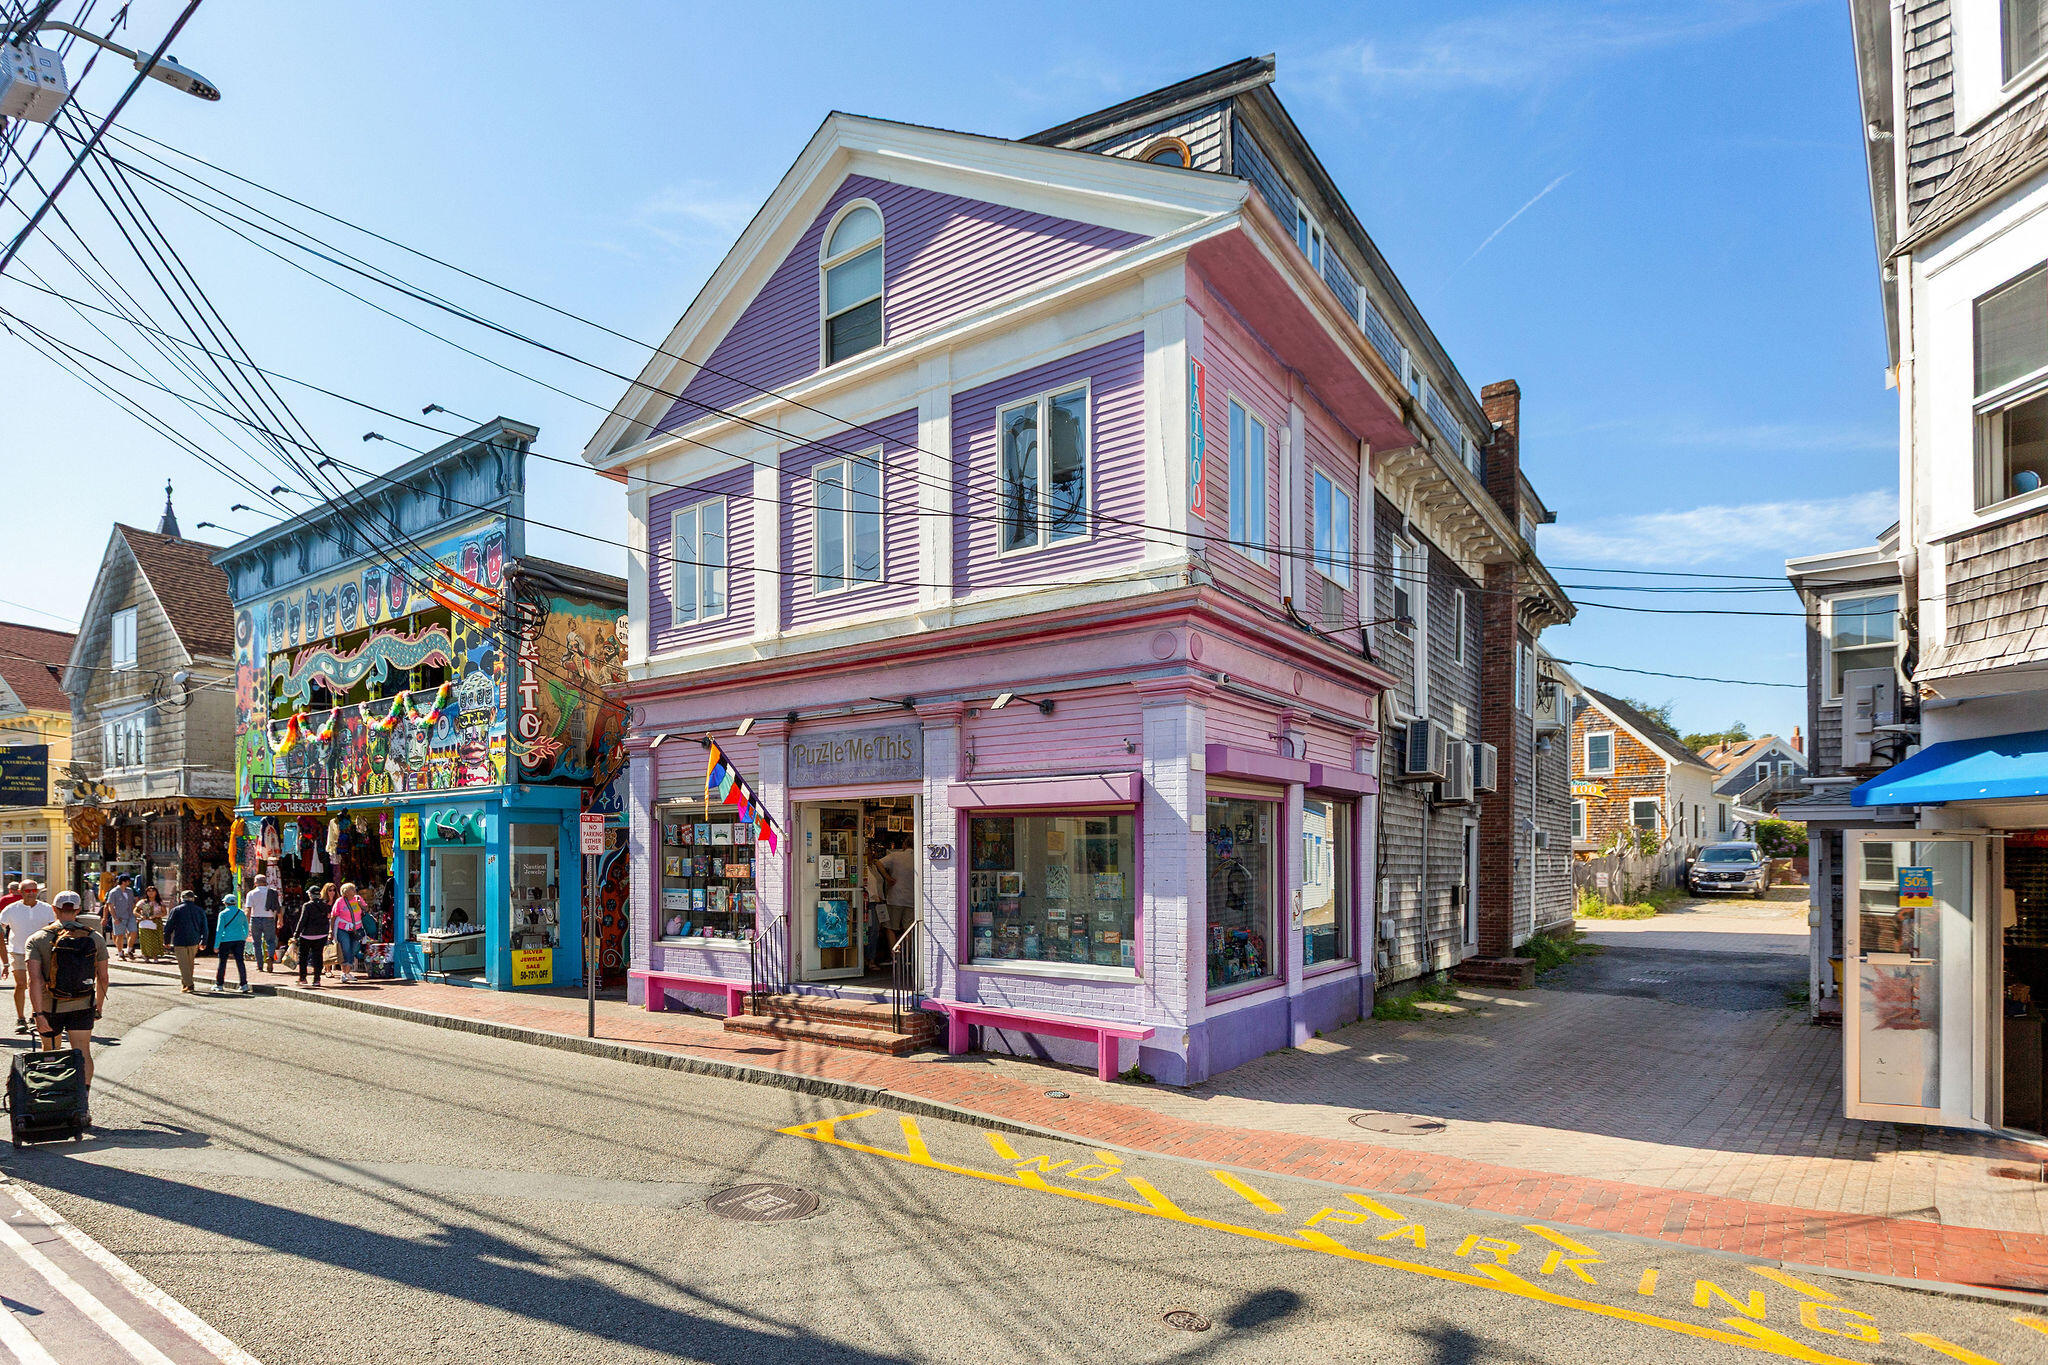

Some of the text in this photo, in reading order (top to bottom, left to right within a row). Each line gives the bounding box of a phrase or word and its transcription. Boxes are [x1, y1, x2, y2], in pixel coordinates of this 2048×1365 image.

[1191, 360, 1202, 509] TATTOO
[518, 602, 541, 768] TATTOO
[260, 802, 323, 813] SHOP THERAPY
[1904, 876, 1928, 887] 50%
[538, 970, 548, 979] OFF
[1013, 1155, 1881, 1344] NO PARKING
